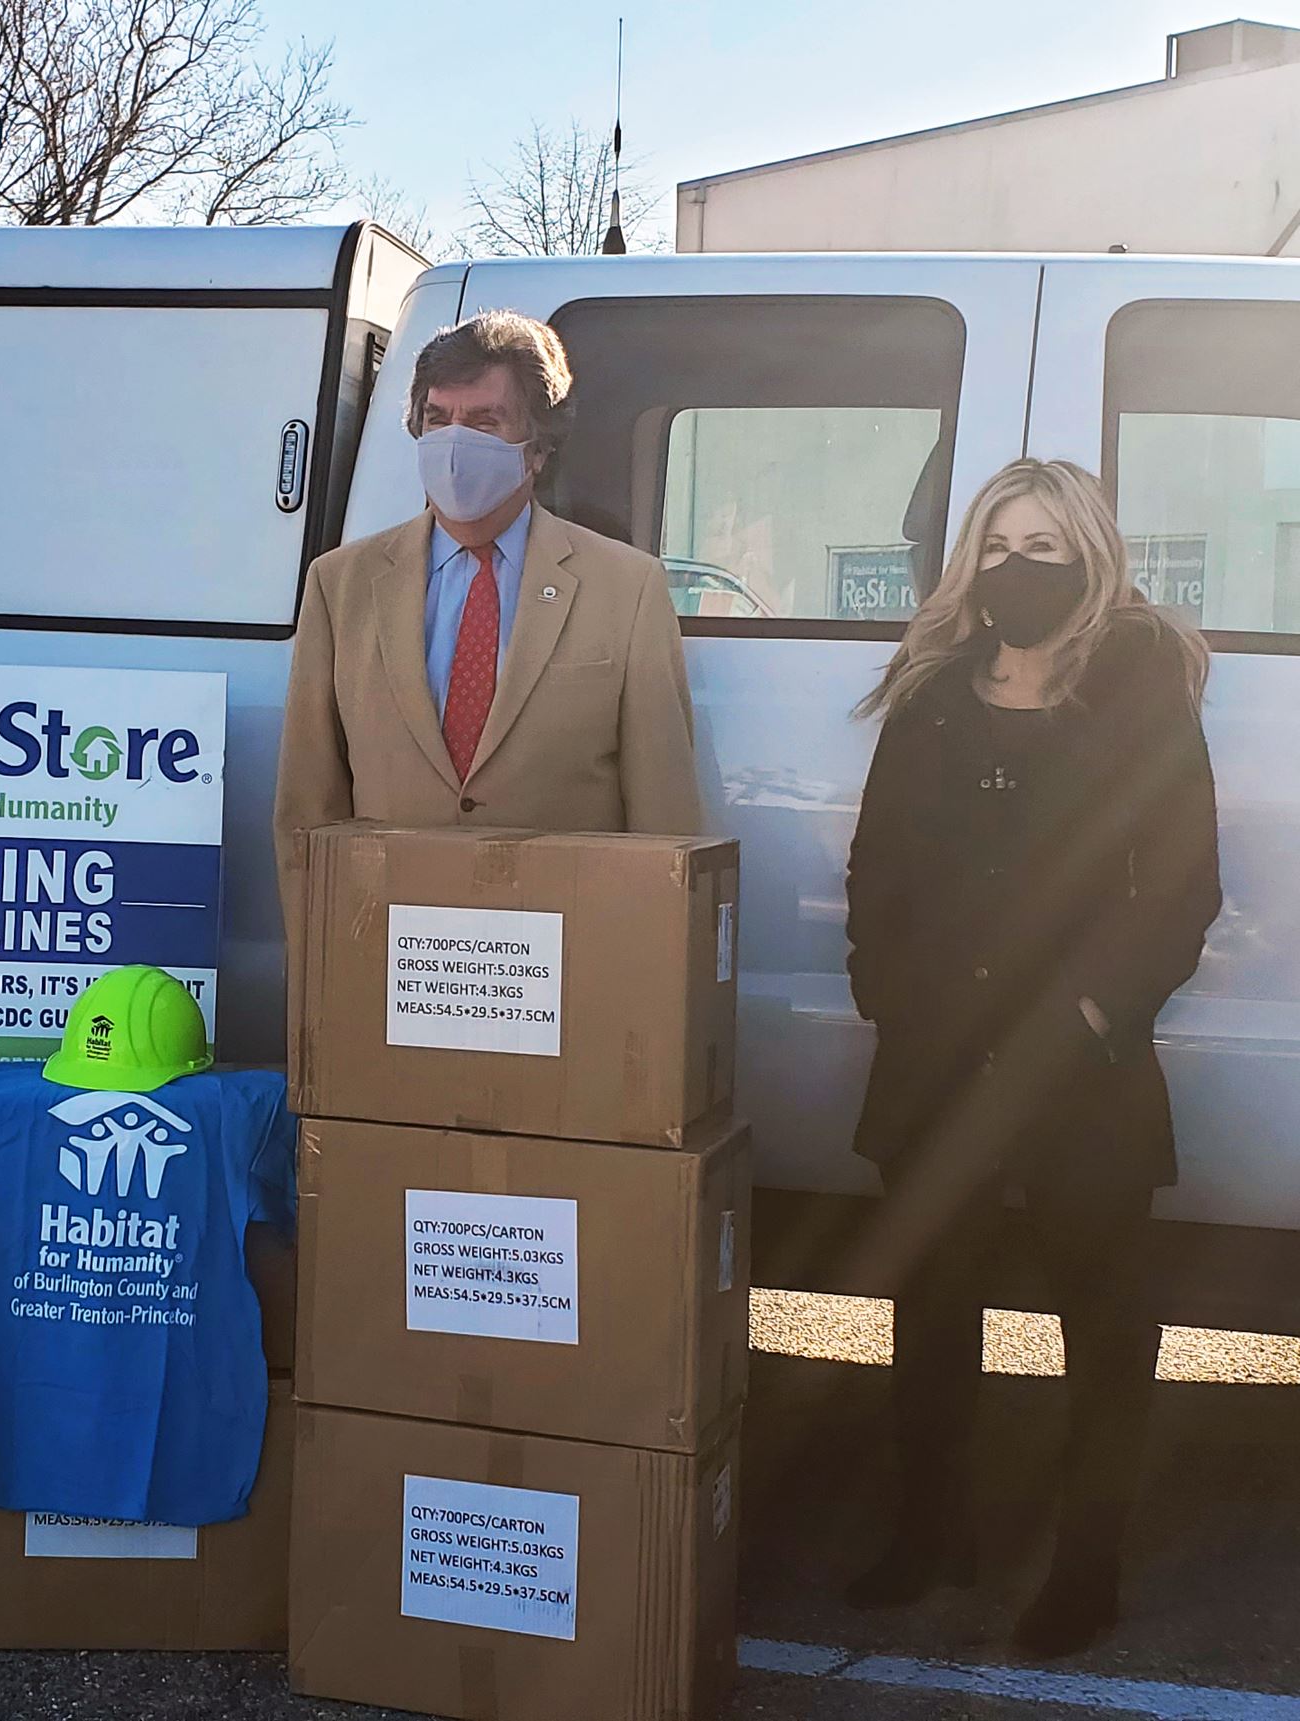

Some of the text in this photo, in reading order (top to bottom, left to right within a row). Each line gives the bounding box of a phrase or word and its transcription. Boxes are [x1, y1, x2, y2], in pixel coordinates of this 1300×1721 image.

[397, 936, 530, 955] QTY:700PCS/CARTON
[397, 958, 549, 979] GROSS WEIGHT:5.03KGS
[41, 975, 79, 996] IT'S
[397, 980, 523, 999] NET WEIGHT:4.3KGS
[40, 1203, 180, 1249] Habitat
[413, 1220, 544, 1241] QTY:700PCS/CARTON
[39, 1245, 70, 1268] for
[413, 1242, 564, 1265] GROSS WEIGHT:5.03KGS
[414, 1263, 538, 1285] NET WEIGHT:4.3KGS
[13, 1272, 199, 1301] of Burlington County and
[10, 1297, 197, 1327] Greater Trenton-Princeton
[411, 1506, 545, 1535] QTY:700PCS/CARTON
[410, 1527, 564, 1560] GROSS WEIGHT:5.03KGS
[410, 1549, 538, 1578] NET WEIGHT:4.3KGS
